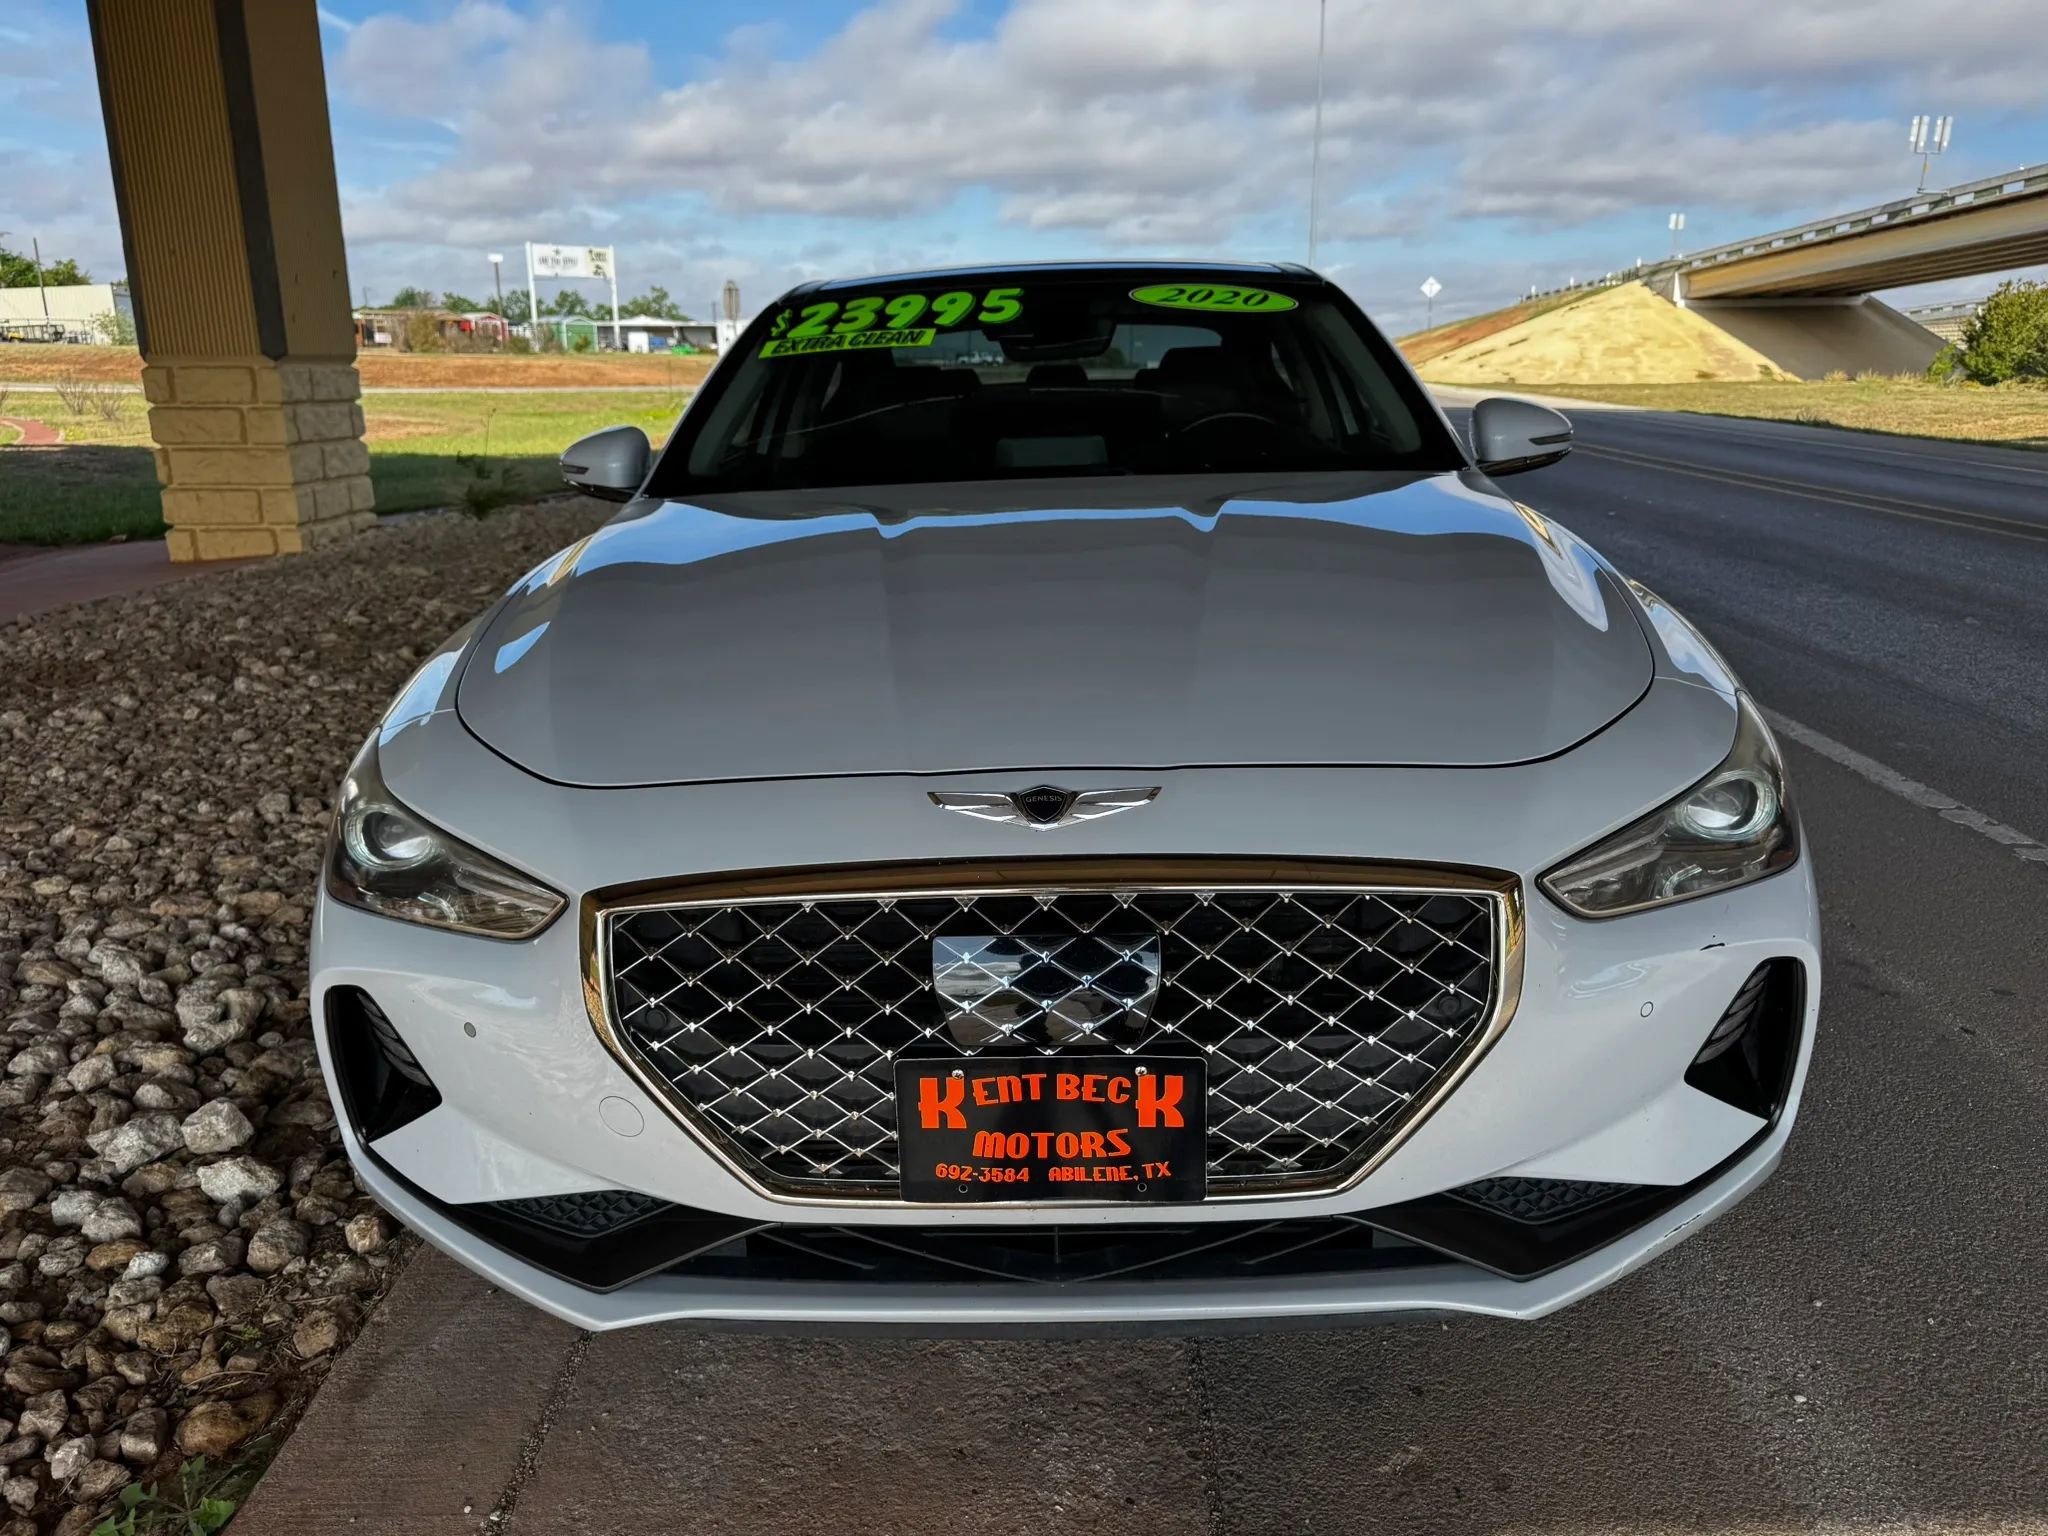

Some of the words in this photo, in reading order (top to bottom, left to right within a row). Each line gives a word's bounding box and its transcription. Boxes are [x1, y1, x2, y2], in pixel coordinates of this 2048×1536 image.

[1156, 288, 1270, 307] 2020
[771, 288, 1025, 338] $23995
[772, 332, 844, 355] EXTRA
[847, 329, 923, 347] CLEAN
[1025, 795, 1063, 803] GENESIS
[917, 1073, 1047, 1129] KENT
[1056, 1073, 1185, 1128] BECK
[972, 1128, 1132, 1159] MOTORS
[935, 1162, 1030, 1183] 692-3584
[1048, 1164, 1140, 1182] ABILENE,
[1142, 1160, 1173, 1180] TX
